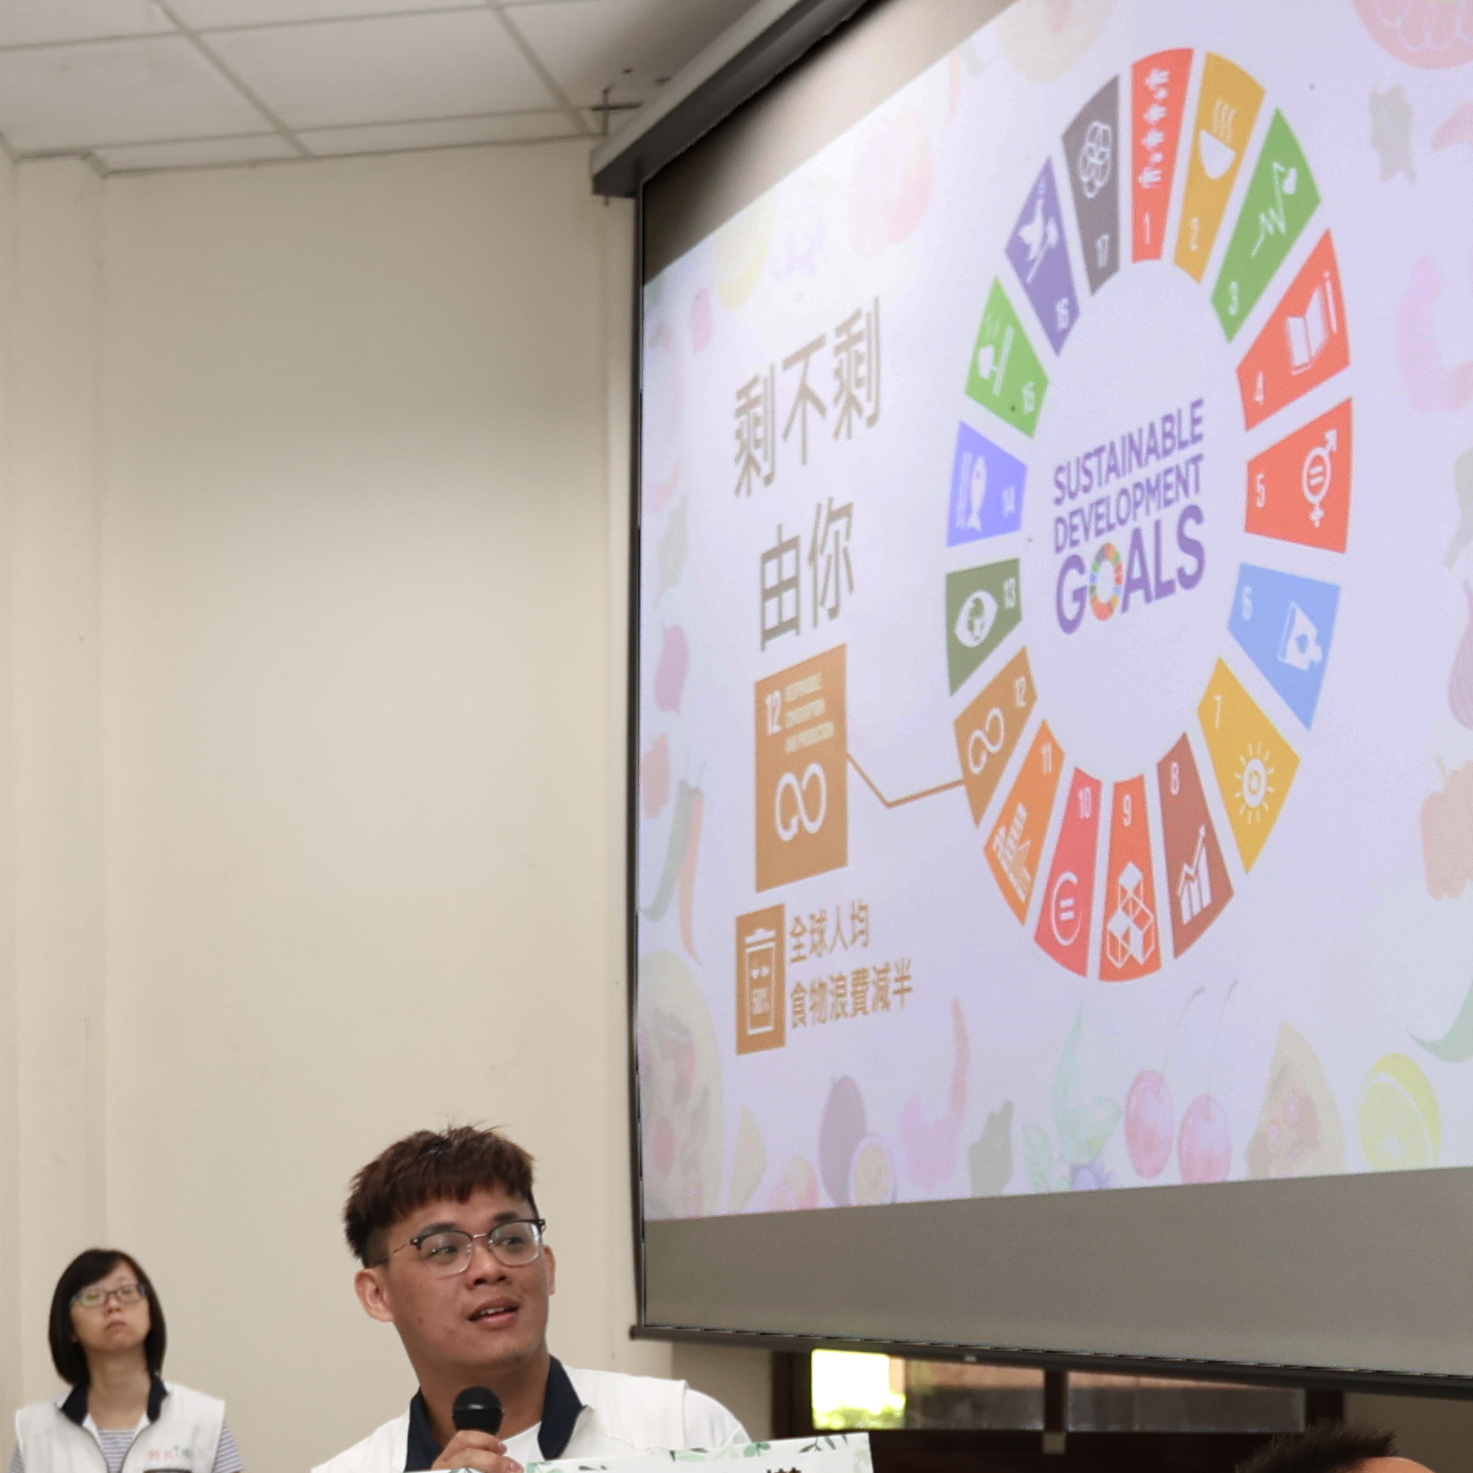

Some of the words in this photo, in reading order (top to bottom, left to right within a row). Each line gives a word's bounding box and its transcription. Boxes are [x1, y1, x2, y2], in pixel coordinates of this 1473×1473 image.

[1142, 213, 1152, 245] 1
[1189, 218, 1200, 250] 2
[1095, 235, 1110, 267] 17
[1228, 282, 1239, 315] 3
[734, 296, 880, 498] 剩不剩
[1254, 373, 1265, 406] 4
[1054, 398, 1203, 506] SUSTAINABLE
[1054, 453, 1203, 554] DEVELOPMENT
[1256, 474, 1266, 508] 5
[761, 497, 854, 652] 由你
[1056, 504, 1205, 634] GOALS
[765, 690, 782, 736] 12
[1213, 695, 1223, 728] 7
[1169, 761, 1179, 795] 8
[1122, 795, 1132, 827] 9
[790, 898, 869, 963] 全球人均
[790, 957, 913, 1029] 食物浪費減半
